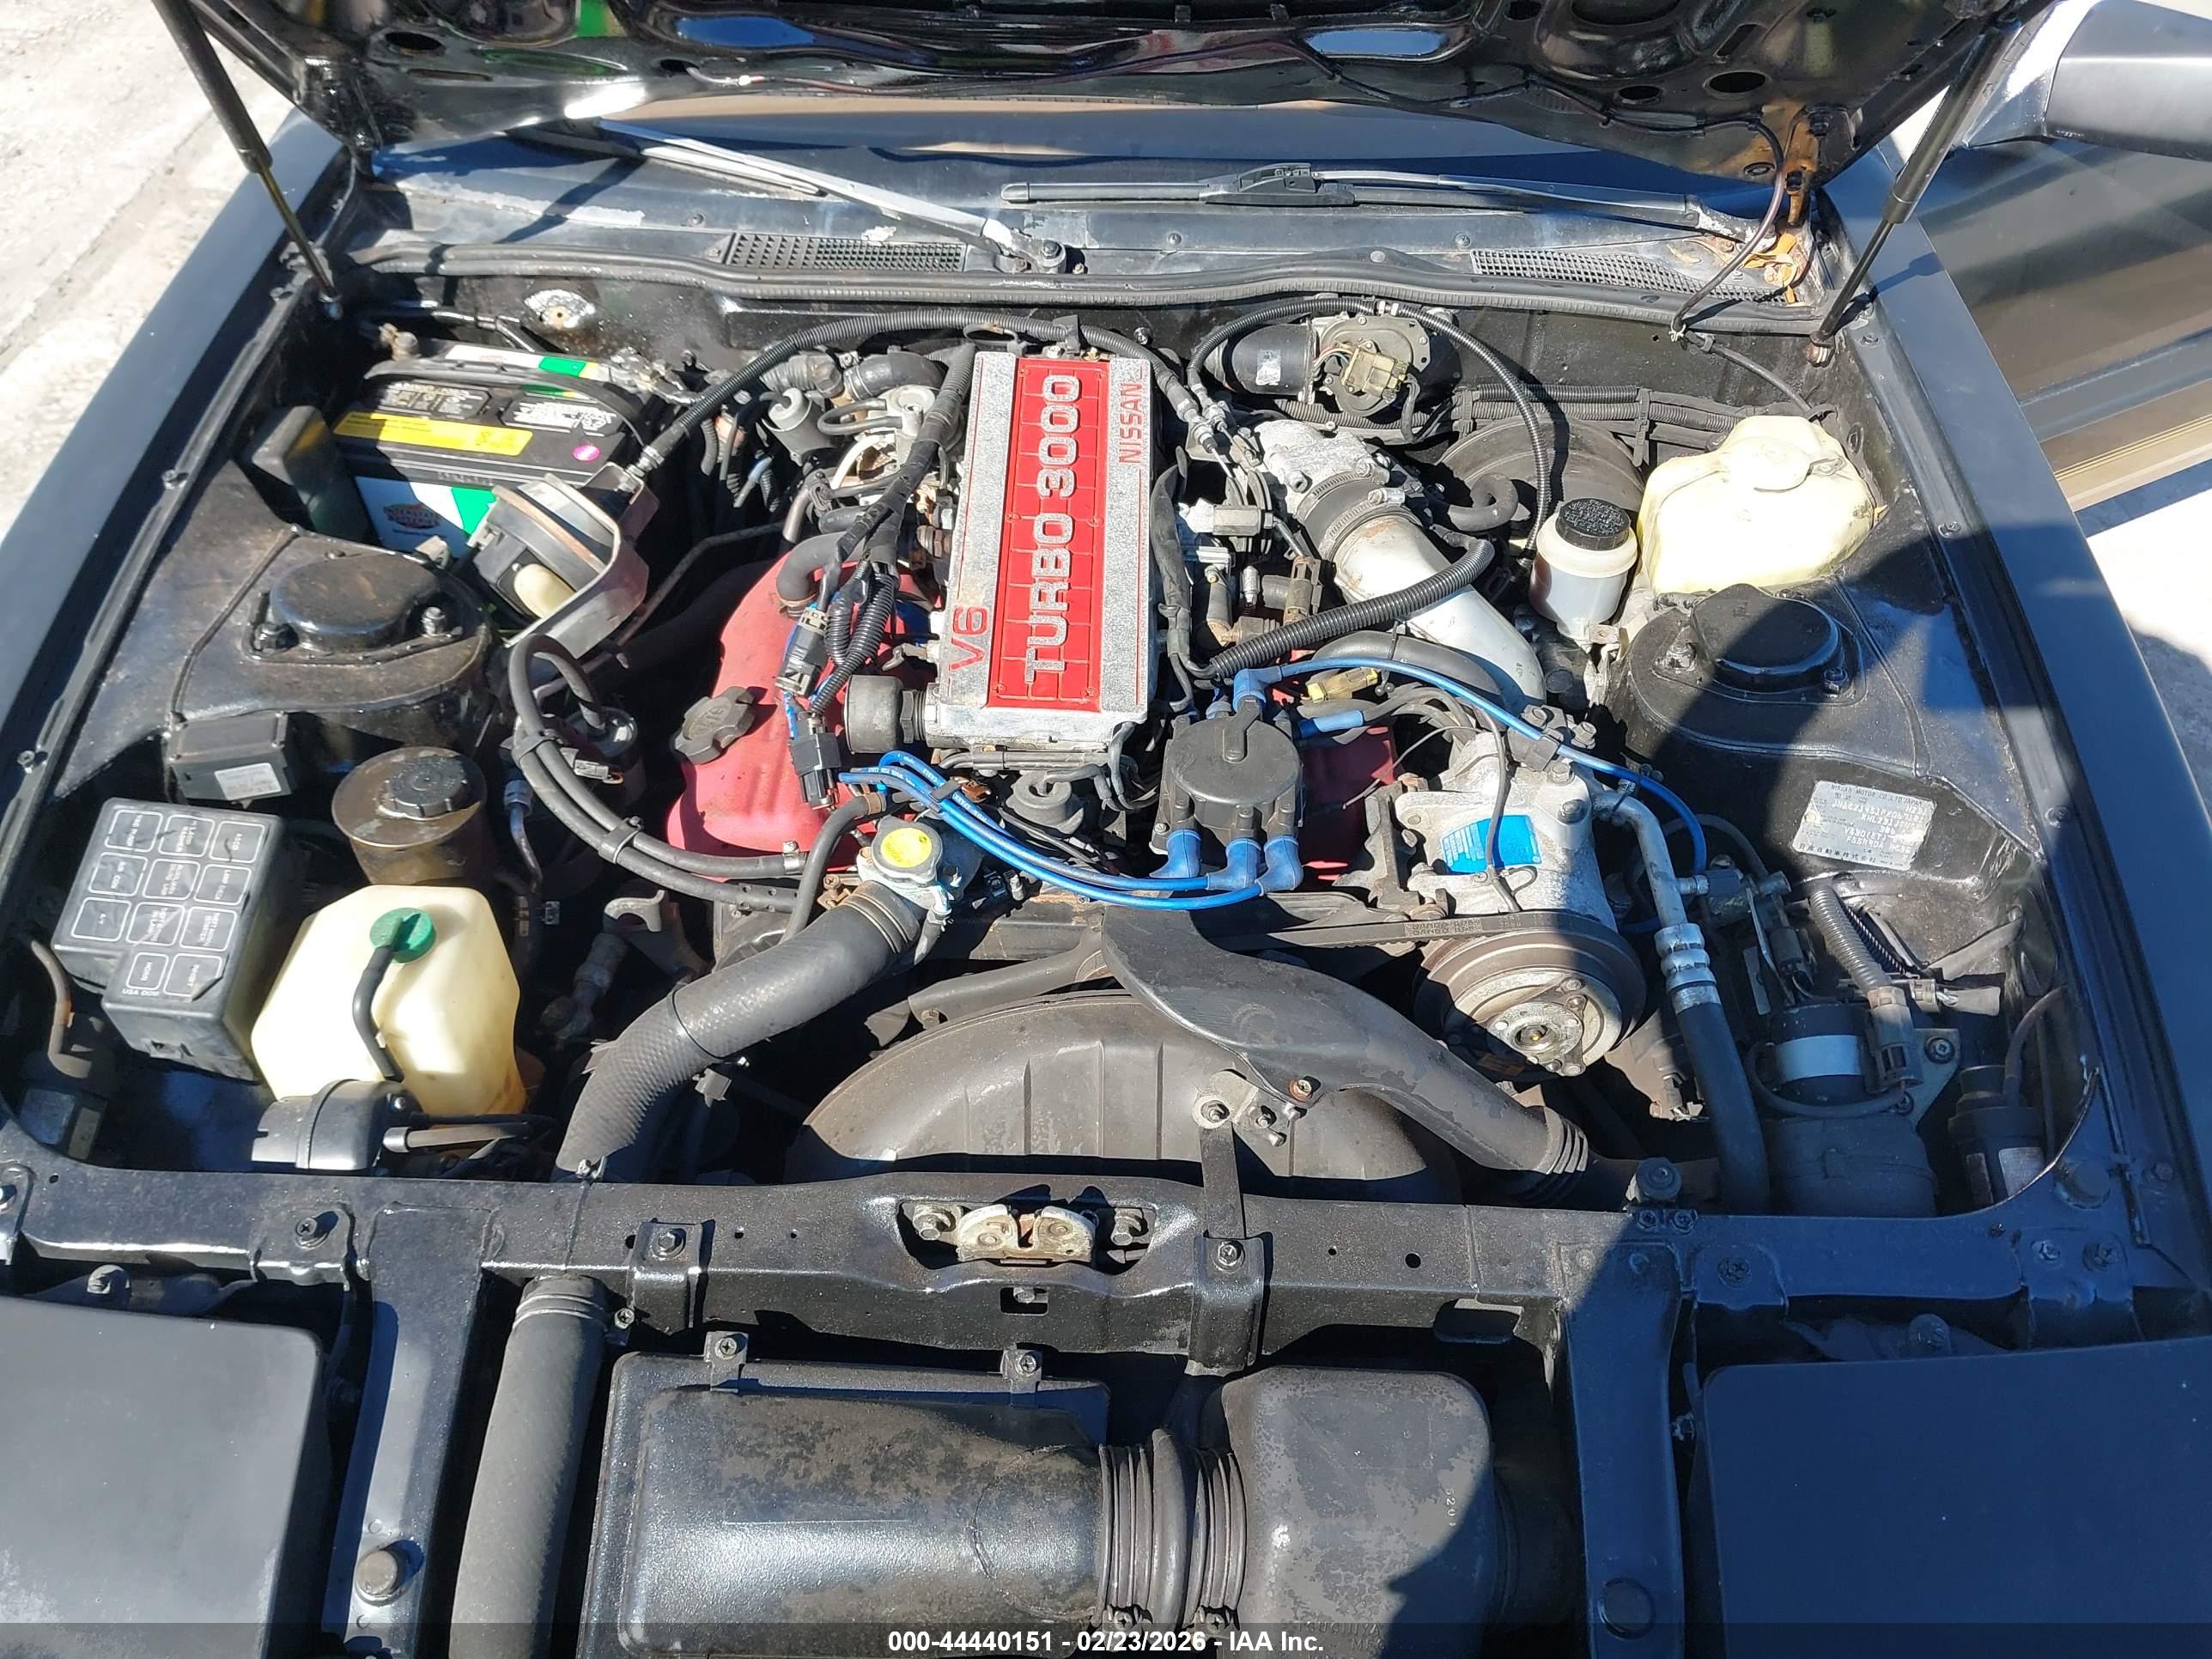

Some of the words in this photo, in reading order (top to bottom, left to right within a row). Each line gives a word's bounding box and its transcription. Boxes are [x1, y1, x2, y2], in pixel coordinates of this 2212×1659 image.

[1036, 374, 1080, 499] 3000
[1118, 380, 1144, 465] NISSAN
[947, 605, 990, 673] V6
[1025, 512, 1074, 684] TURBO
[1831, 784, 1852, 793] NISSAN
[1856, 788, 1876, 798] MOTOR
